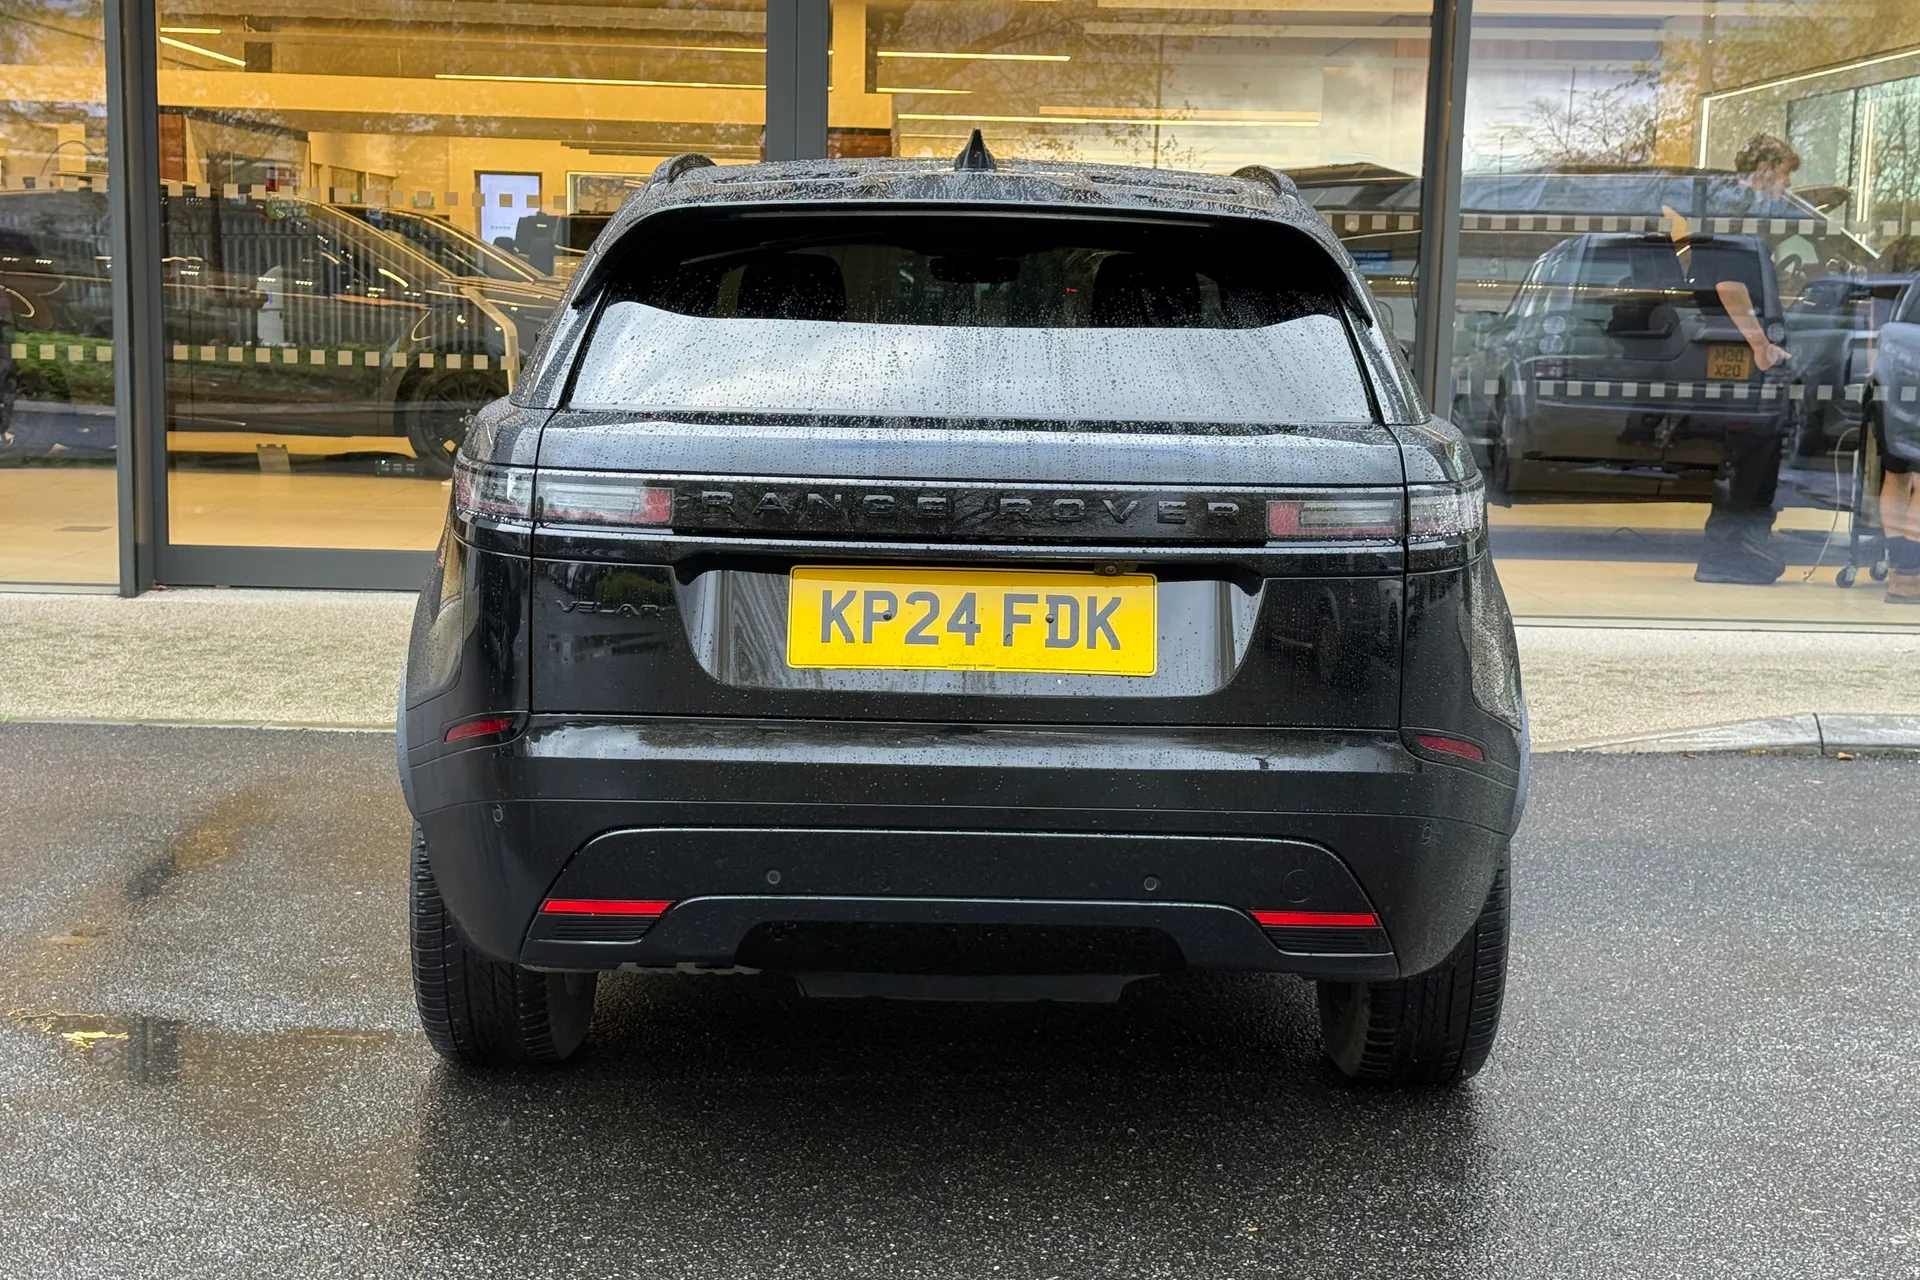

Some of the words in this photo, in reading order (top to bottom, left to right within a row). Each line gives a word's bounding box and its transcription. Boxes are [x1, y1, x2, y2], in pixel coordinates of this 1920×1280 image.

[702, 491, 947, 519] RANGE
[1000, 498, 1241, 525] ROVER
[556, 600, 661, 618] VELAR
[820, 590, 981, 645] KP24
[1003, 593, 1122, 650] FDK
